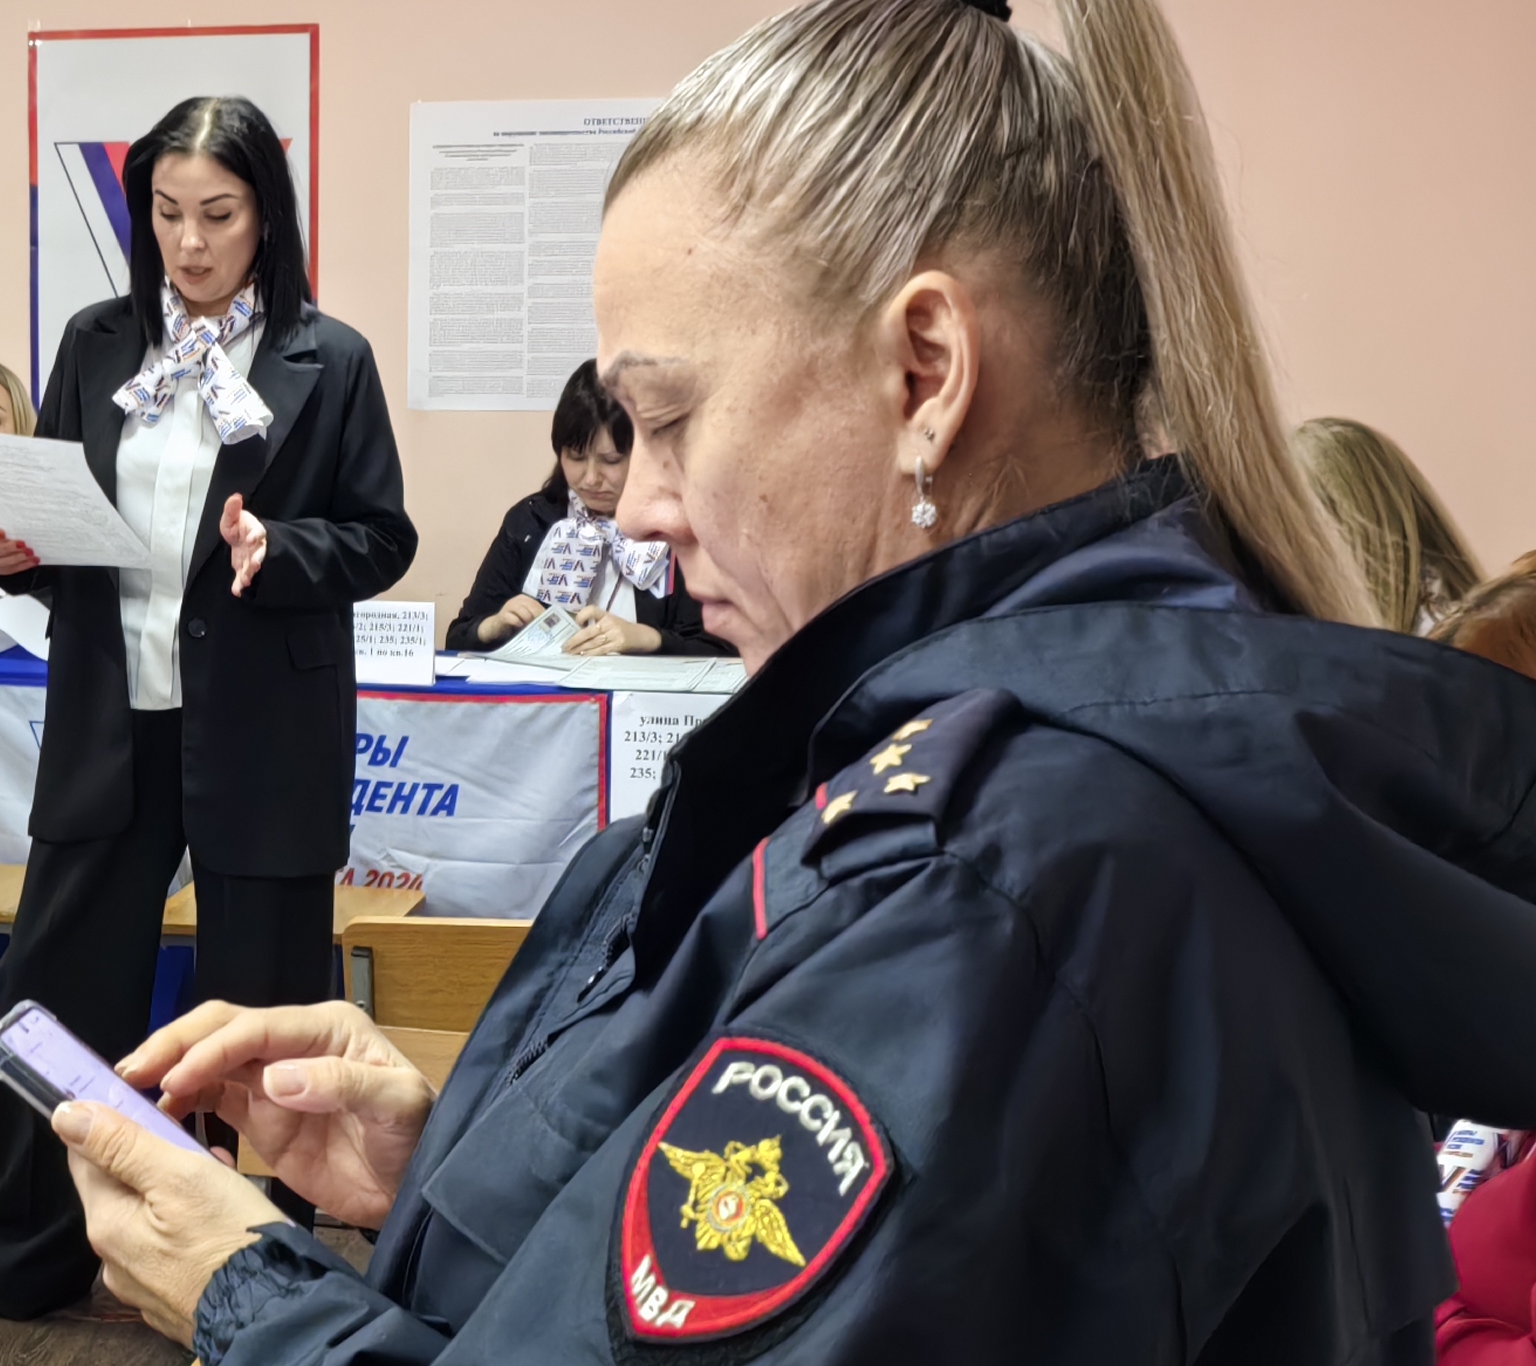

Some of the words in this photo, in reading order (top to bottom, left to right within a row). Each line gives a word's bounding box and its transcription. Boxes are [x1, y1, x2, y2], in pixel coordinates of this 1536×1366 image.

[639, 715, 679, 727] улица
[624, 731, 662, 744] 213/3;
[630, 767, 656, 780] 235;
[711, 1060, 866, 1196] РОССИЯ
[630, 1254, 695, 1328] МВД
